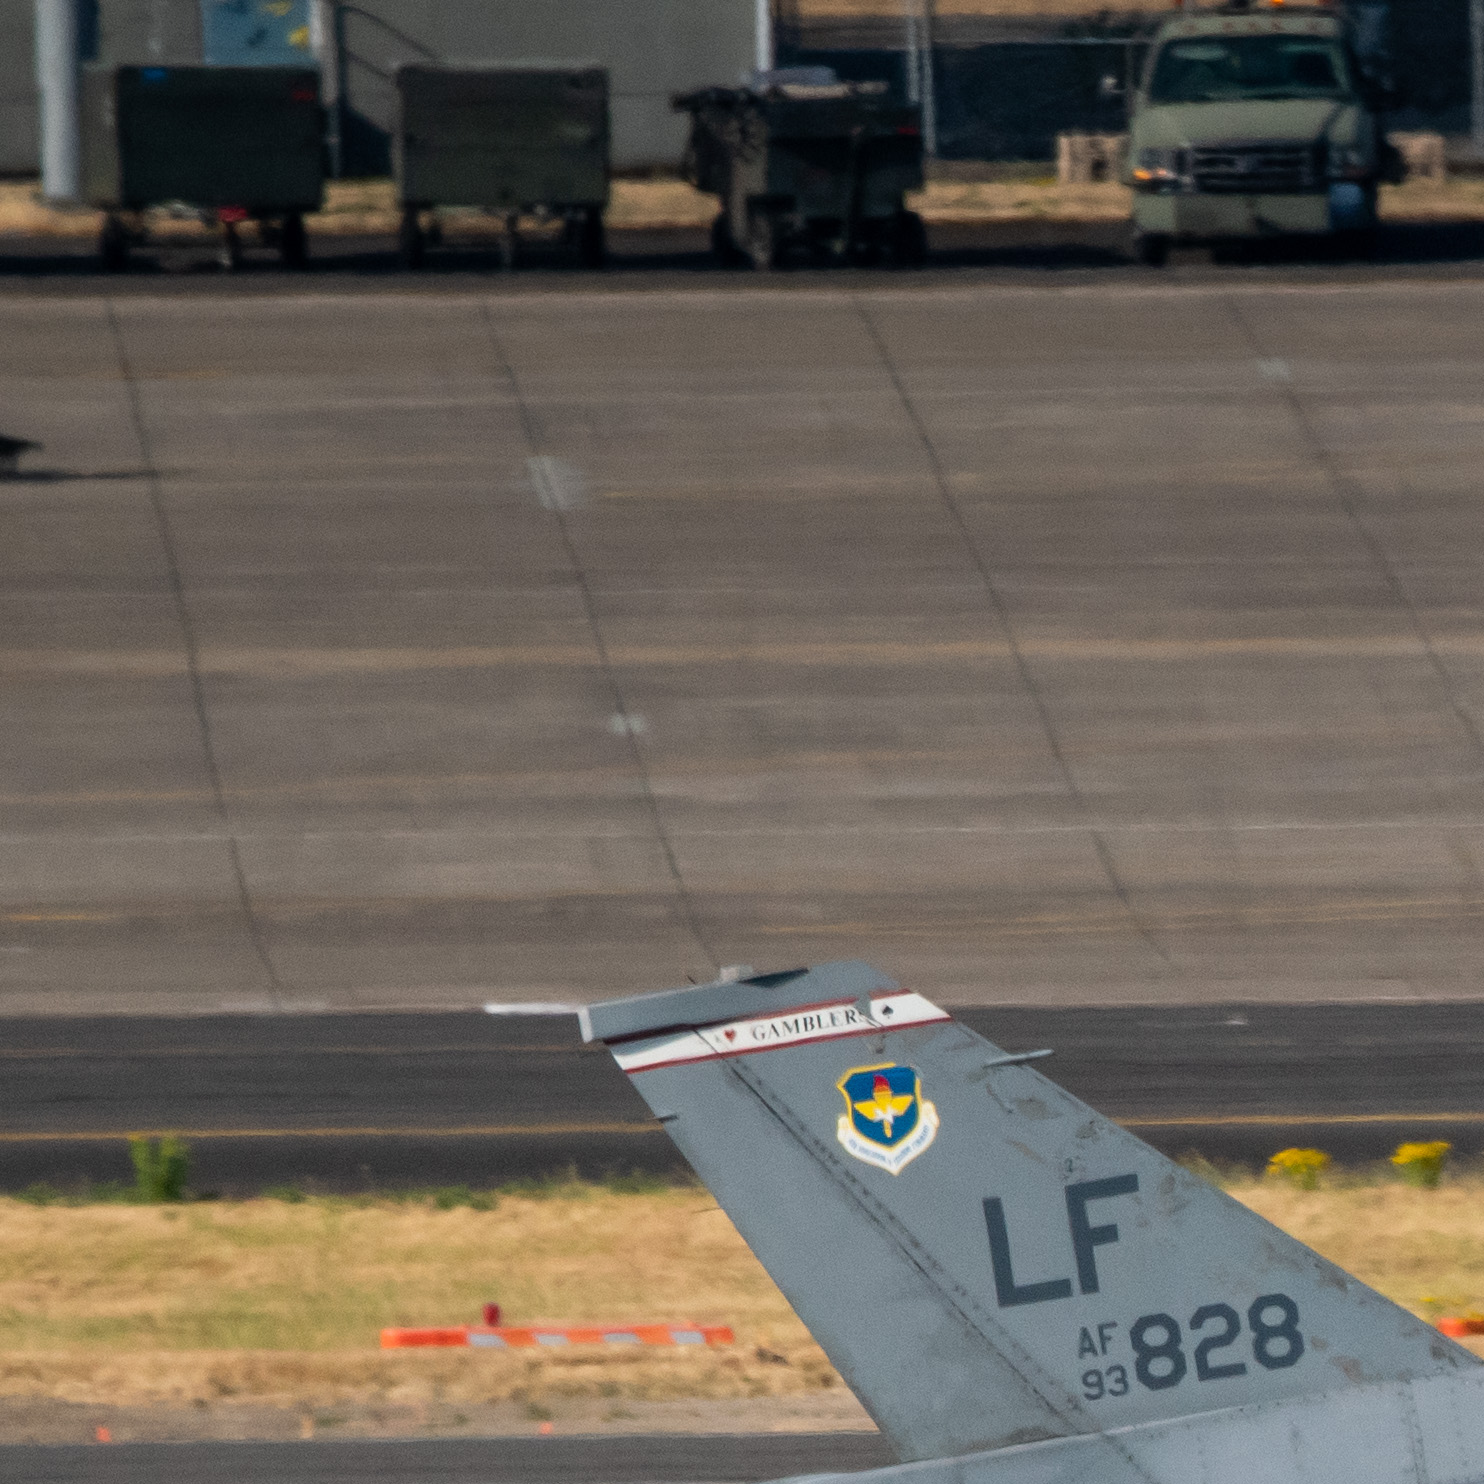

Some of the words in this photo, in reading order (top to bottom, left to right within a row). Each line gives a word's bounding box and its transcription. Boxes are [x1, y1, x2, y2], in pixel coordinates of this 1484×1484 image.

[982, 1173, 1139, 1308] LF
[1079, 1320, 1118, 1358] AF
[1129, 1293, 1305, 1391] 828
[1081, 1364, 1129, 1400] 93
